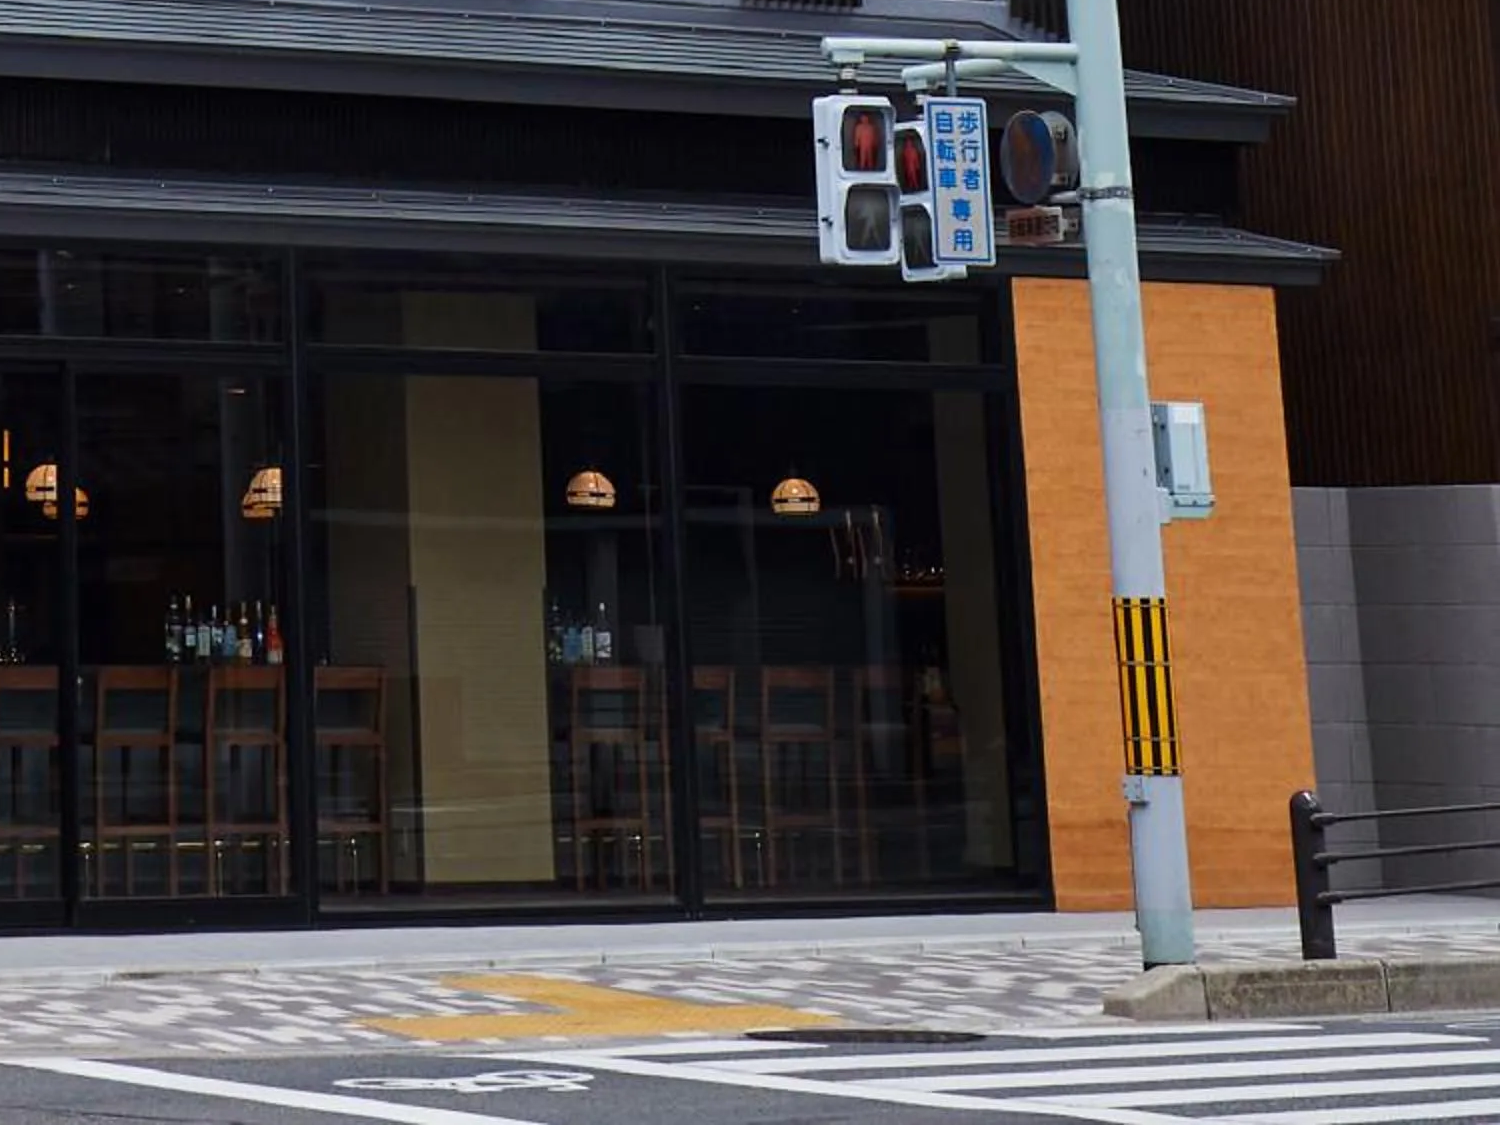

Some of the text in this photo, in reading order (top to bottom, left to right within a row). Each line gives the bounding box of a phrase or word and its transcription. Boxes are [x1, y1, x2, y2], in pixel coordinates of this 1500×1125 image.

[935, 110, 957, 188] 自転車
[957, 111, 981, 190] 歩行者
[952, 198, 973, 252] 専用
